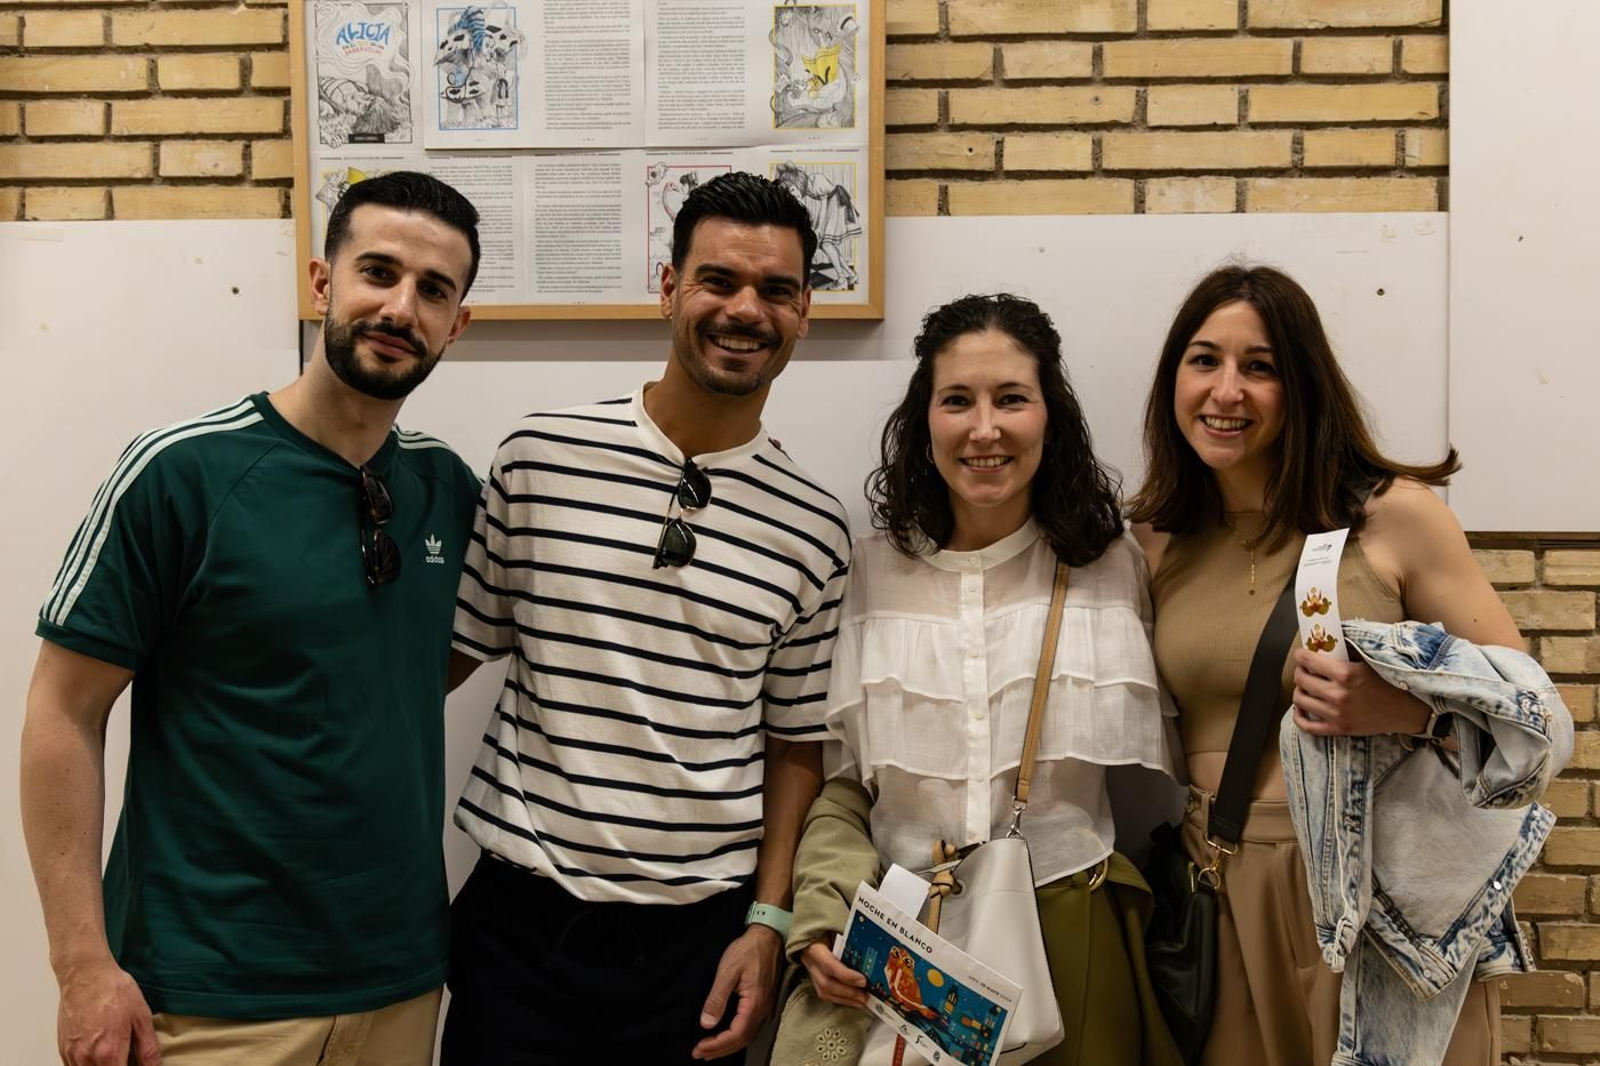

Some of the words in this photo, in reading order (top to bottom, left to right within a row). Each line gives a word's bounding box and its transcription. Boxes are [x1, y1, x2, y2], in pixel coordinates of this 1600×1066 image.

[336, 22, 391, 46] ALICIA
[857, 896, 885, 921] NOCHE
[886, 918, 898, 930] EN
[898, 927, 933, 954] BLANCO
